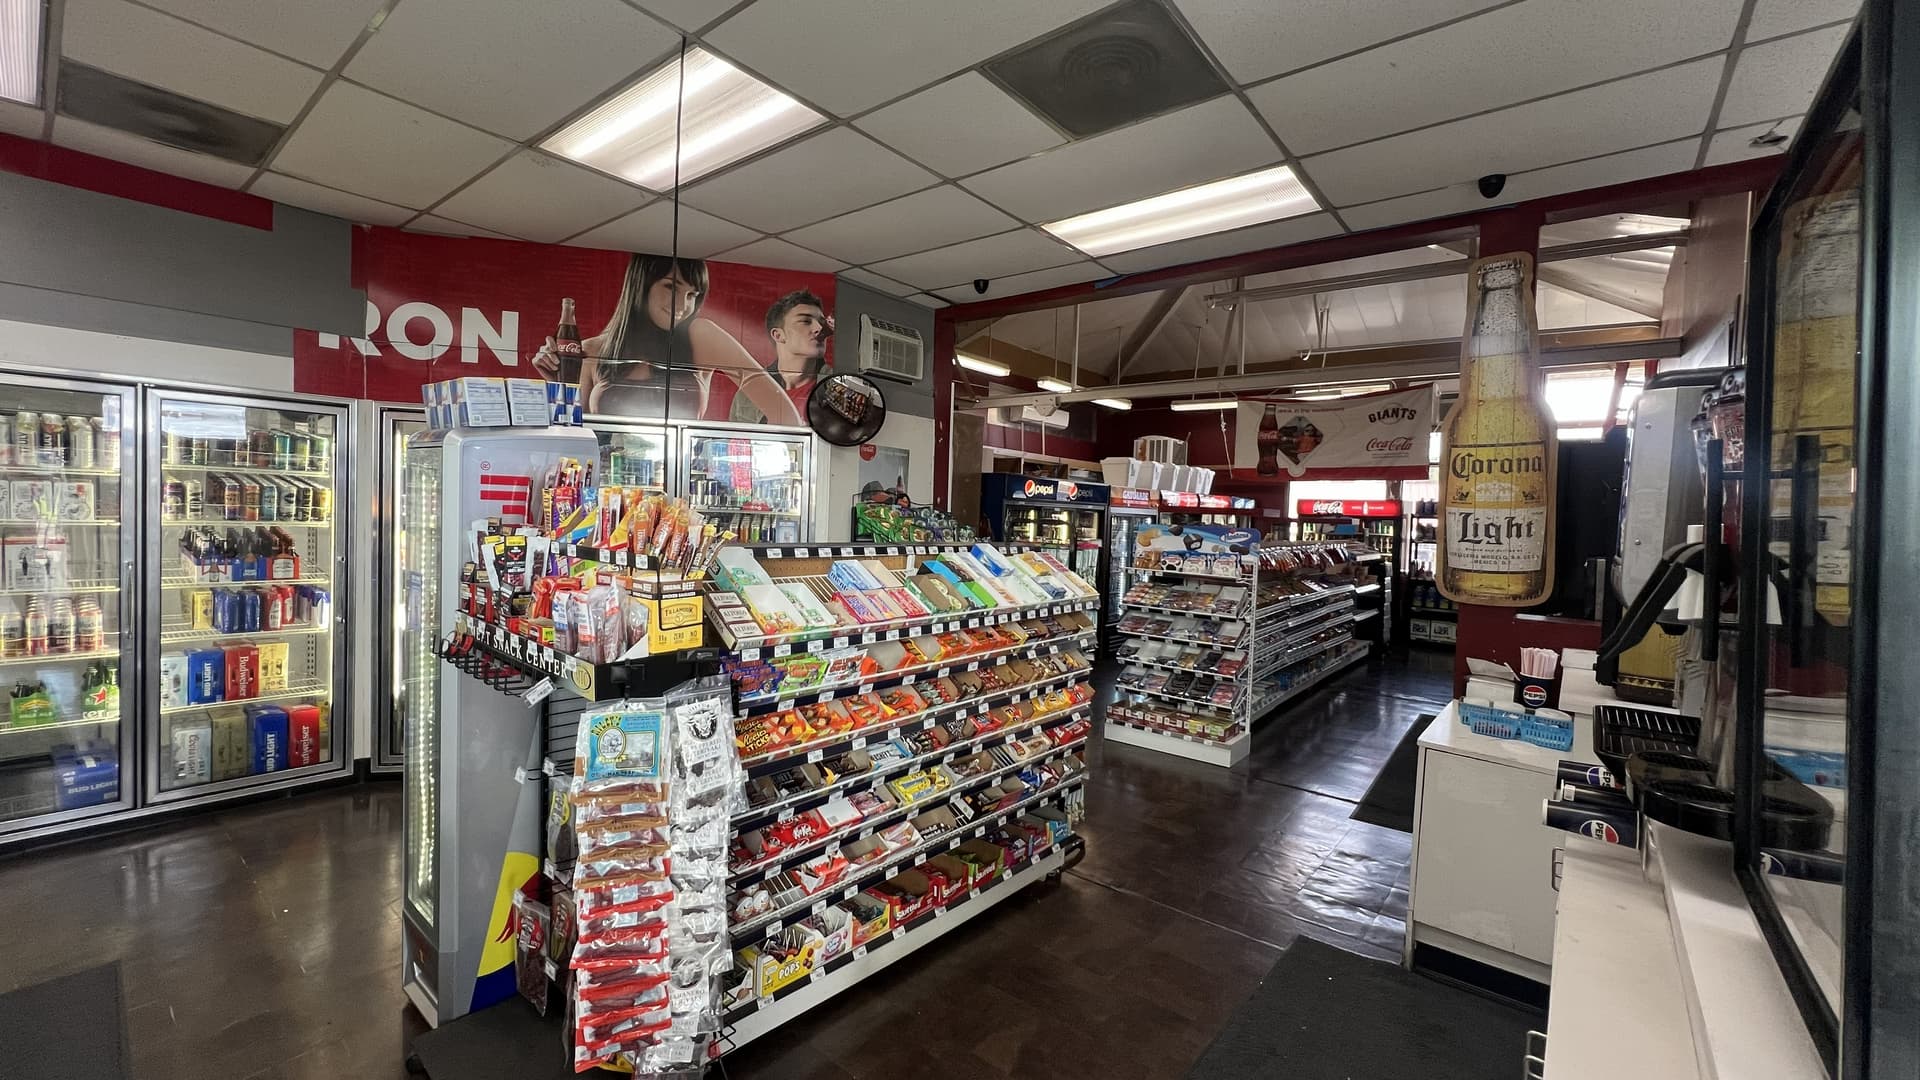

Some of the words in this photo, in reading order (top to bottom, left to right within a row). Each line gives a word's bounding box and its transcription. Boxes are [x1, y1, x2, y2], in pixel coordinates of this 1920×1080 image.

[1368, 407, 1417, 424] GIANTS
[1452, 452, 1542, 482] Corona
[1034, 485, 1053, 496] pepsi
[1458, 511, 1534, 545] Light
[665, 606, 694, 617] TILLAMOOK
[472, 623, 491, 646] EAT
[493, 634, 523, 661] SNACK
[526, 651, 568, 679] CENTER
[203, 662, 212, 681] LIGHT
[239, 655, 250, 697] Budweiser
[1523, 691, 1546, 699] PEPSI
[266, 733, 275, 756] LIGHT
[302, 725, 311, 764] udweiser
[266, 757, 275, 772] UD
[779, 960, 800, 980] POPS
